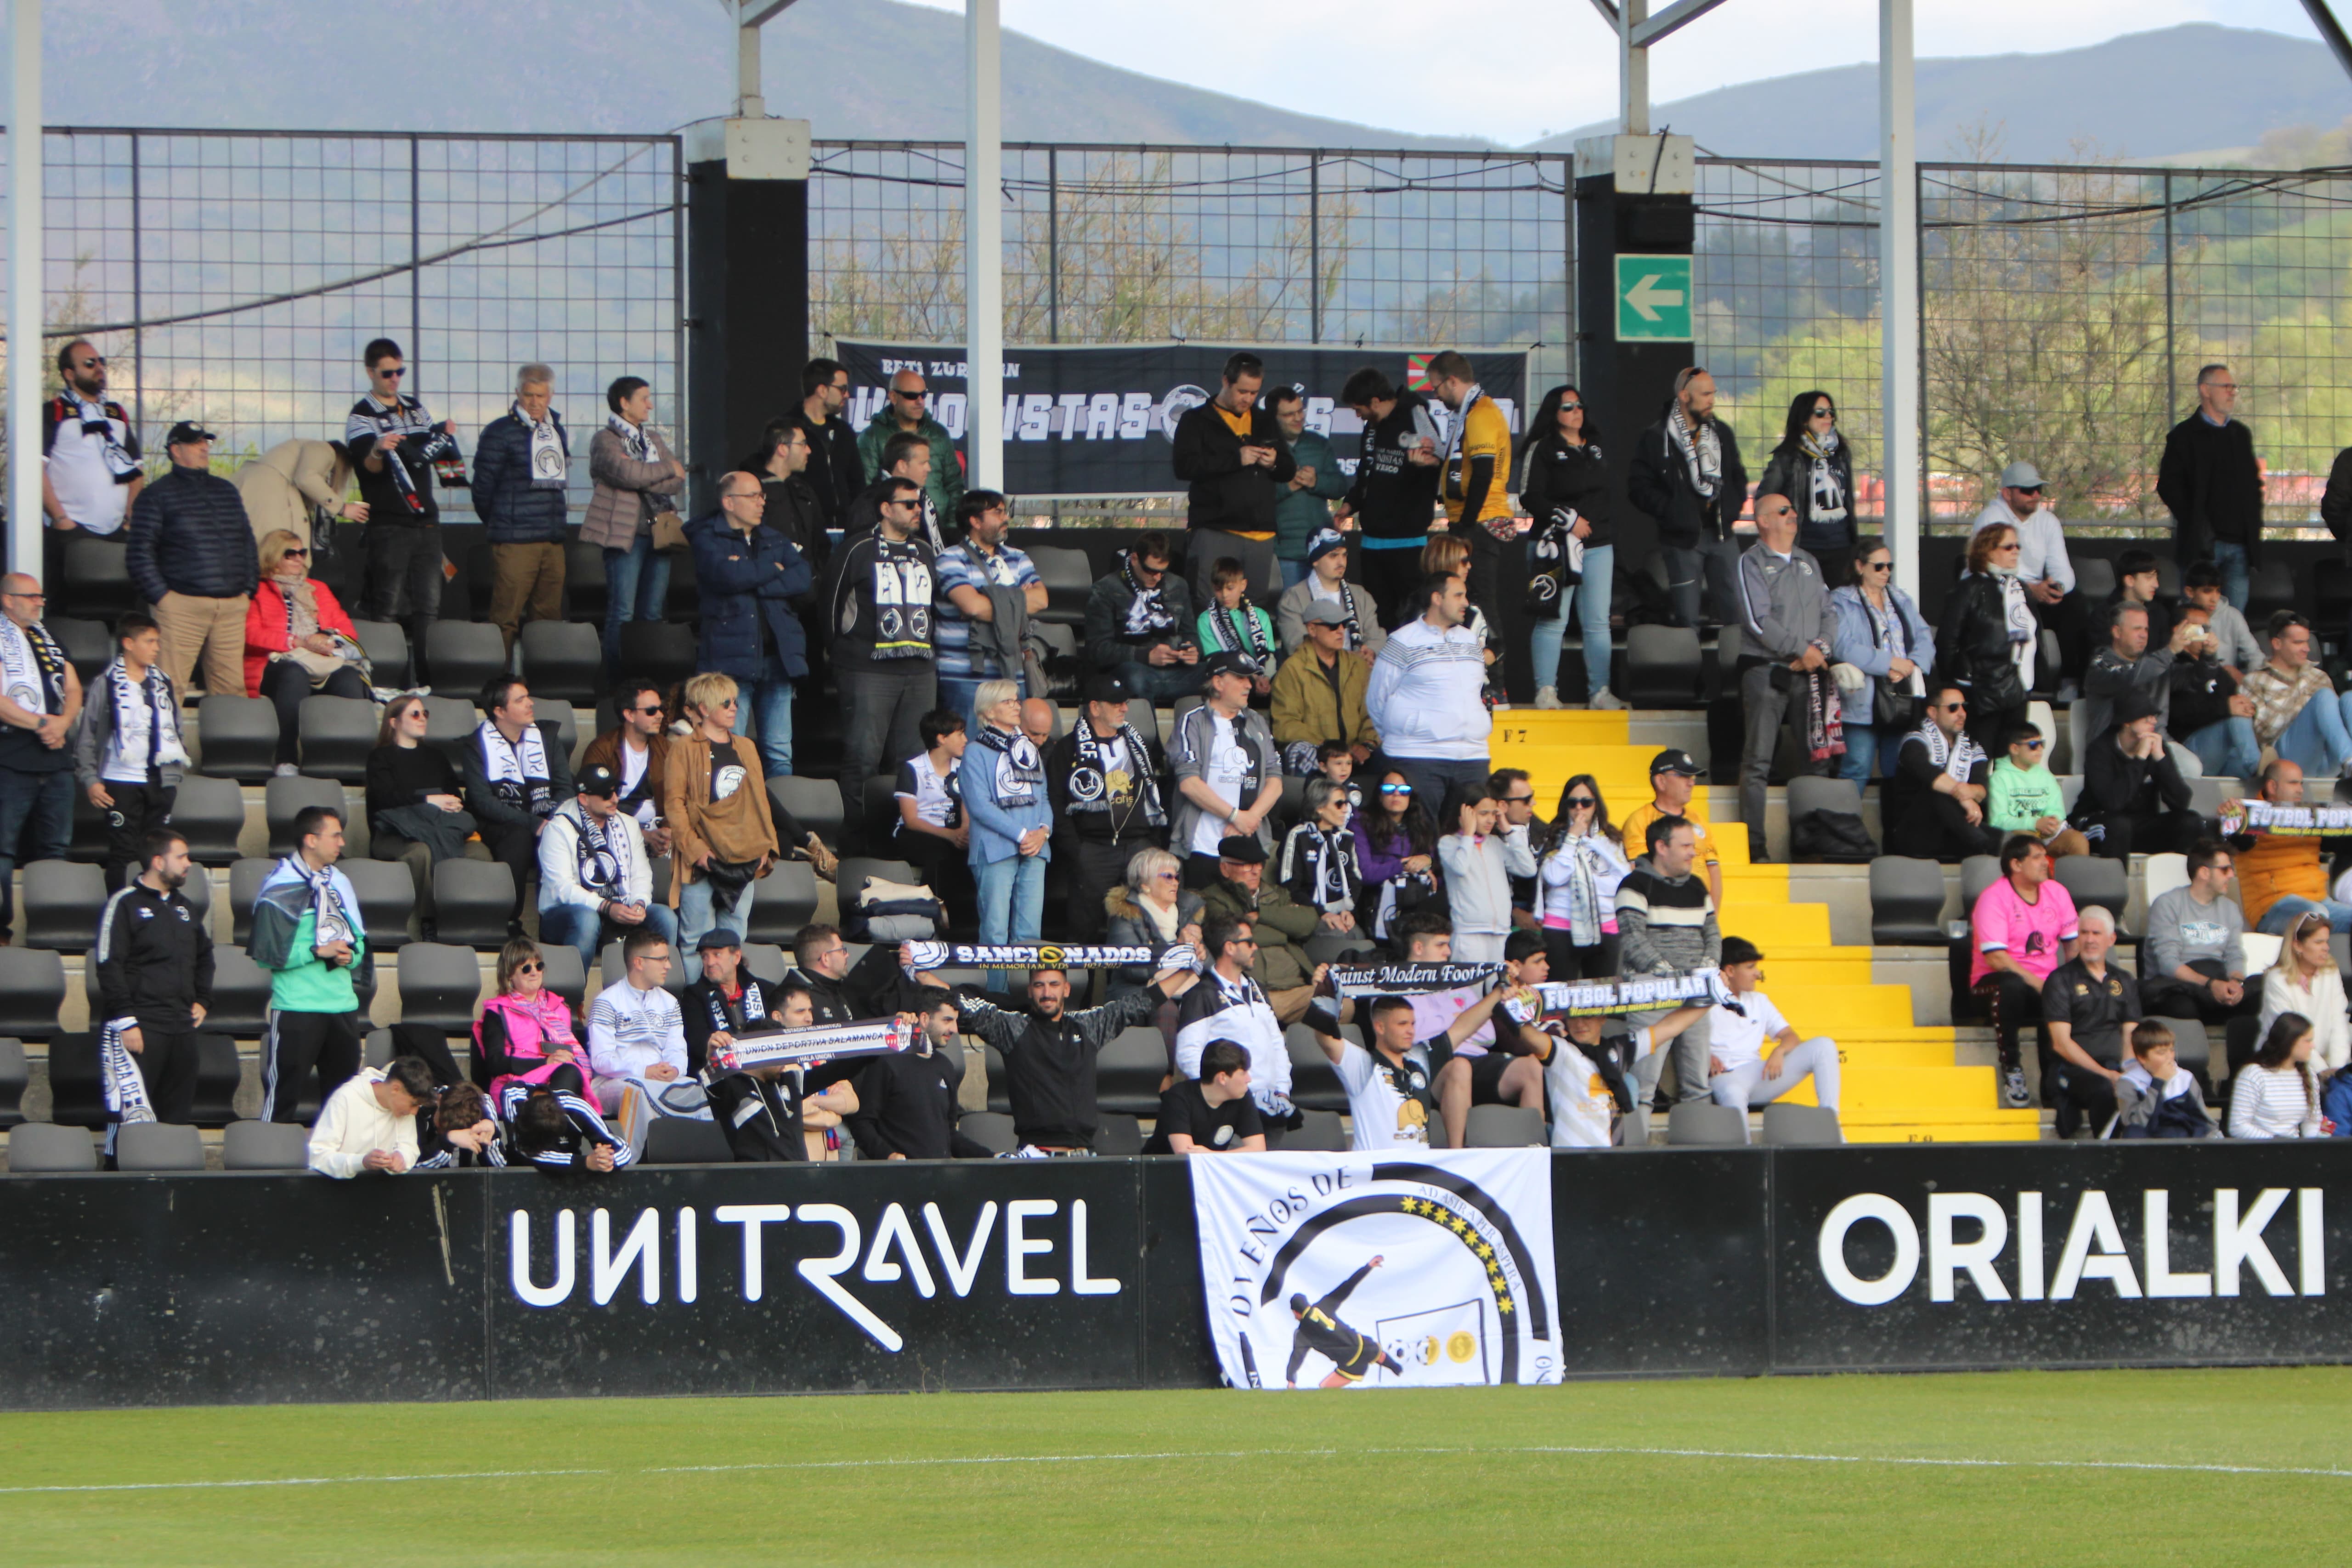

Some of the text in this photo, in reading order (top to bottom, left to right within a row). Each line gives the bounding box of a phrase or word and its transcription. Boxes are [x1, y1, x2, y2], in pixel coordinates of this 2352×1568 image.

[853, 385, 1153, 441] UOISTAS
[1504, 730, 1527, 742] F 7
[2316, 807, 2352, 828] POP
[1378, 963, 1437, 984] Modern
[1543, 974, 1708, 1011] FUTBOL POPULAR
[745, 1031, 883, 1055] UNION DEPORTIVA SALAMANCA
[783, 1026, 807, 1034] ESTADIO
[1312, 1165, 1353, 1197] DE
[1418, 1184, 1438, 1199] AD
[1440, 1192, 1476, 1222] ASTRA
[1476, 1214, 1497, 1241] PER
[1818, 1187, 2326, 1306] ORIALKI
[510, 1198, 1122, 1353] UNITRAVEL
